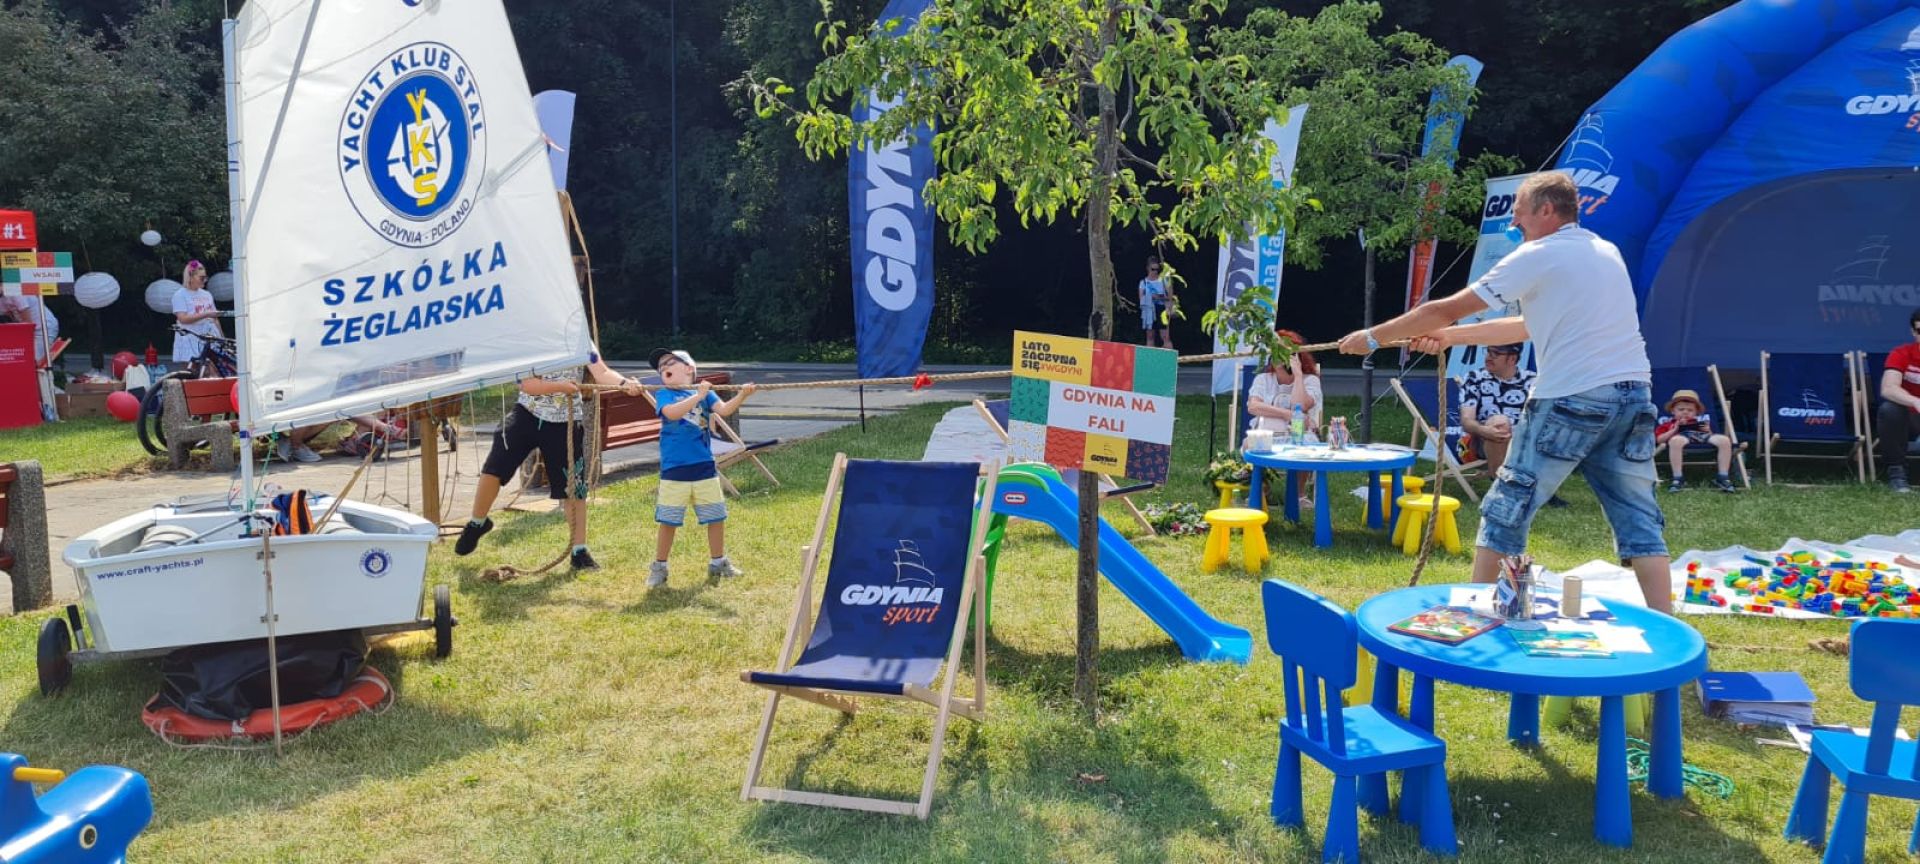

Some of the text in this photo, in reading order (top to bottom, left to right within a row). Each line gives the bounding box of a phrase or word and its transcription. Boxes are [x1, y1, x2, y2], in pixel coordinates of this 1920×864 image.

[344, 48, 484, 173] YACHT KLUB STAL
[1845, 94, 1920, 115] GDY
[3, 223, 26, 239] #1
[379, 219, 423, 244] GDYNIA
[431, 198, 470, 241] POLAND
[323, 241, 507, 306] SZKÓŁKA
[320, 284, 505, 346] ŻEGLARSKA
[1022, 341, 1051, 352] LATO
[1021, 350, 1077, 365] ZACZYNA
[1063, 388, 1156, 413] GDYNIA NA
[1778, 407, 1835, 417] GDYNIA
[1088, 415, 1124, 432] FALI
[97, 557, 204, 580] www.craft-yachts.pl
[840, 584, 944, 605] GDYNIA
[882, 604, 941, 625] sport
